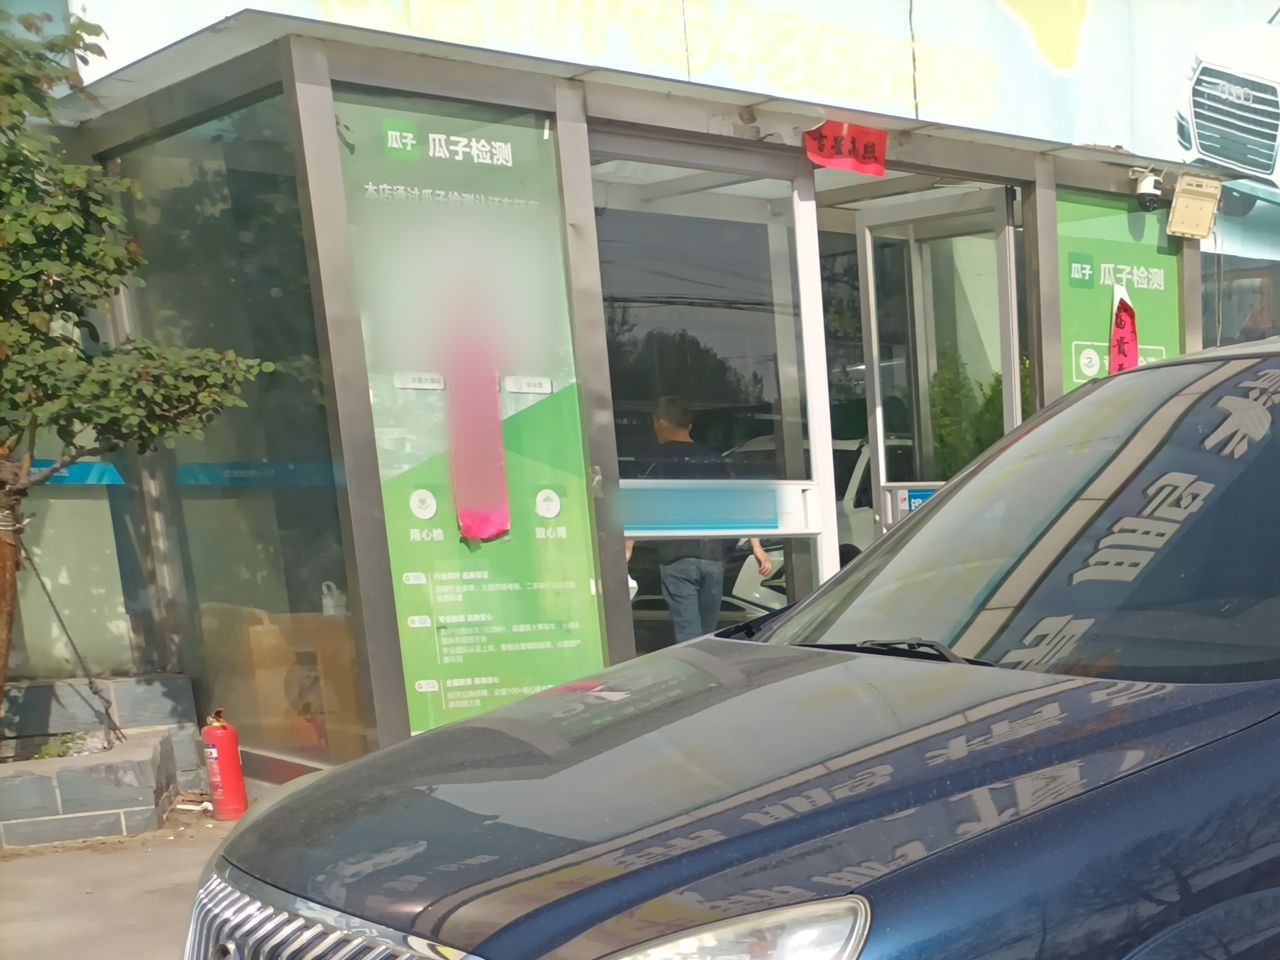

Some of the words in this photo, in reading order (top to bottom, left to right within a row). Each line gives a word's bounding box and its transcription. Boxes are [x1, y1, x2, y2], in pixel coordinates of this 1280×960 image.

[387, 130, 417, 151] 瓜子
[428, 132, 513, 167] 瓜子检测
[1070, 263, 1093, 280] 瓜子
[1099, 263, 1165, 290] 瓜子检测
